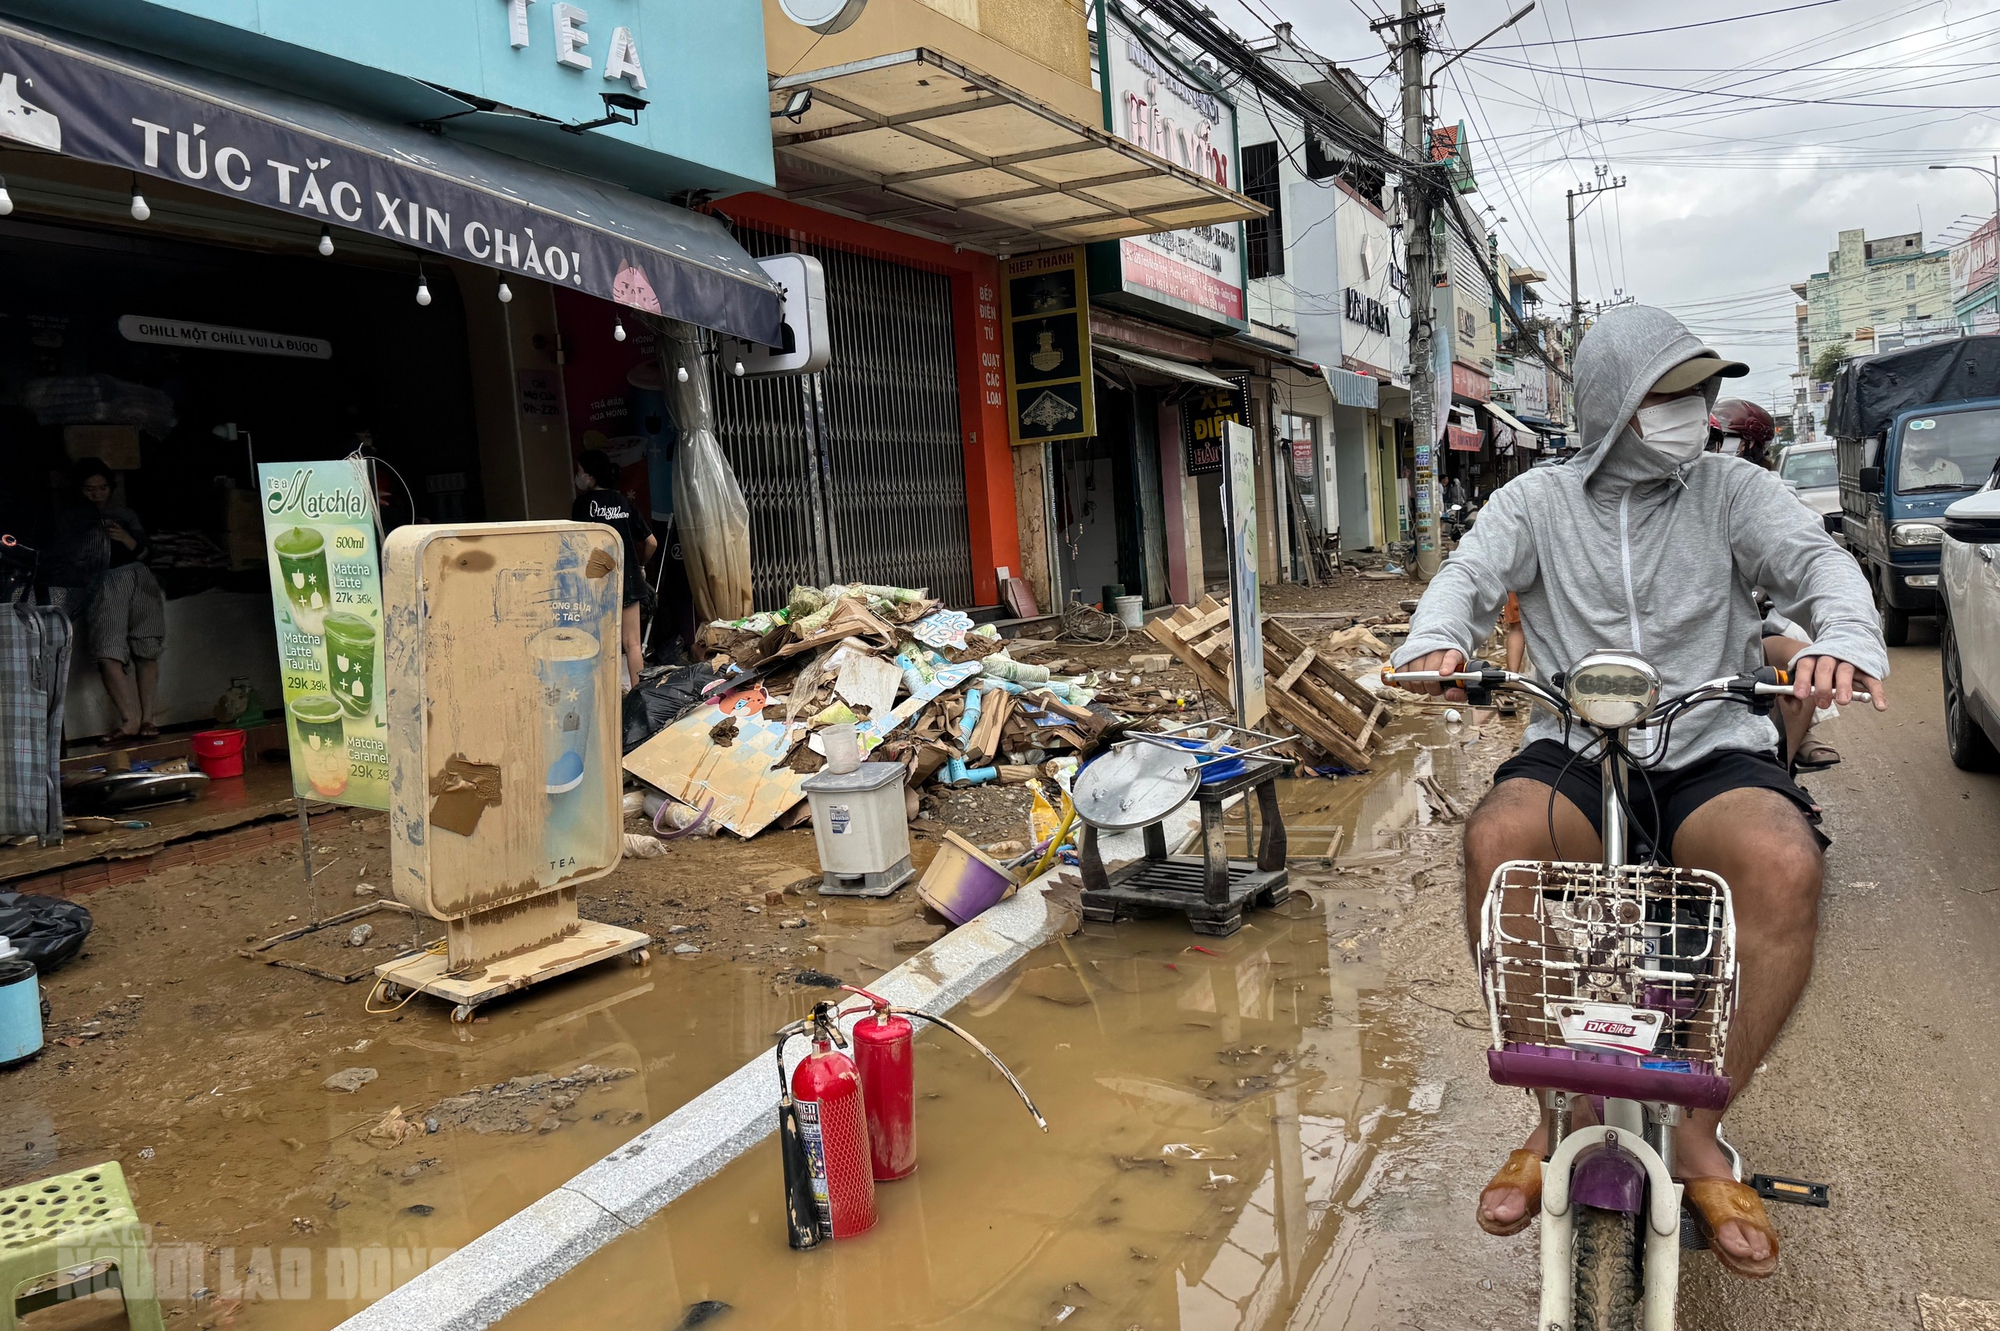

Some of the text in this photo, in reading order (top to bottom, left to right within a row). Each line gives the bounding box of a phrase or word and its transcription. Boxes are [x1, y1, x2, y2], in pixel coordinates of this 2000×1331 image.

[508, 0, 648, 91] TEA
[131, 117, 582, 286] TÚC TẮC XIN CHÀO!
[1008, 252, 1074, 275] HIỆP THÀNH
[979, 284, 993, 302] BẾP
[979, 304, 996, 323] ĐIỆN
[982, 352, 1000, 370] QUẠT
[986, 370, 1000, 386] CÁC
[986, 391, 1002, 409] LOẠI
[1194, 442, 1219, 465] HẢI
[336, 537, 365, 549] 500ml
[332, 564, 370, 576] Matcha
[333, 578, 362, 588] Latte
[335, 592, 353, 603] 27k
[283, 632, 321, 645] Matcha
[285, 646, 312, 657] Latte
[286, 659, 304, 670] Tàu
[287, 676, 309, 690] 29k
[346, 736, 384, 750] Matcha
[347, 749, 389, 764] Caramel
[350, 764, 373, 779] 29k
[550, 856, 575, 870] TEA
